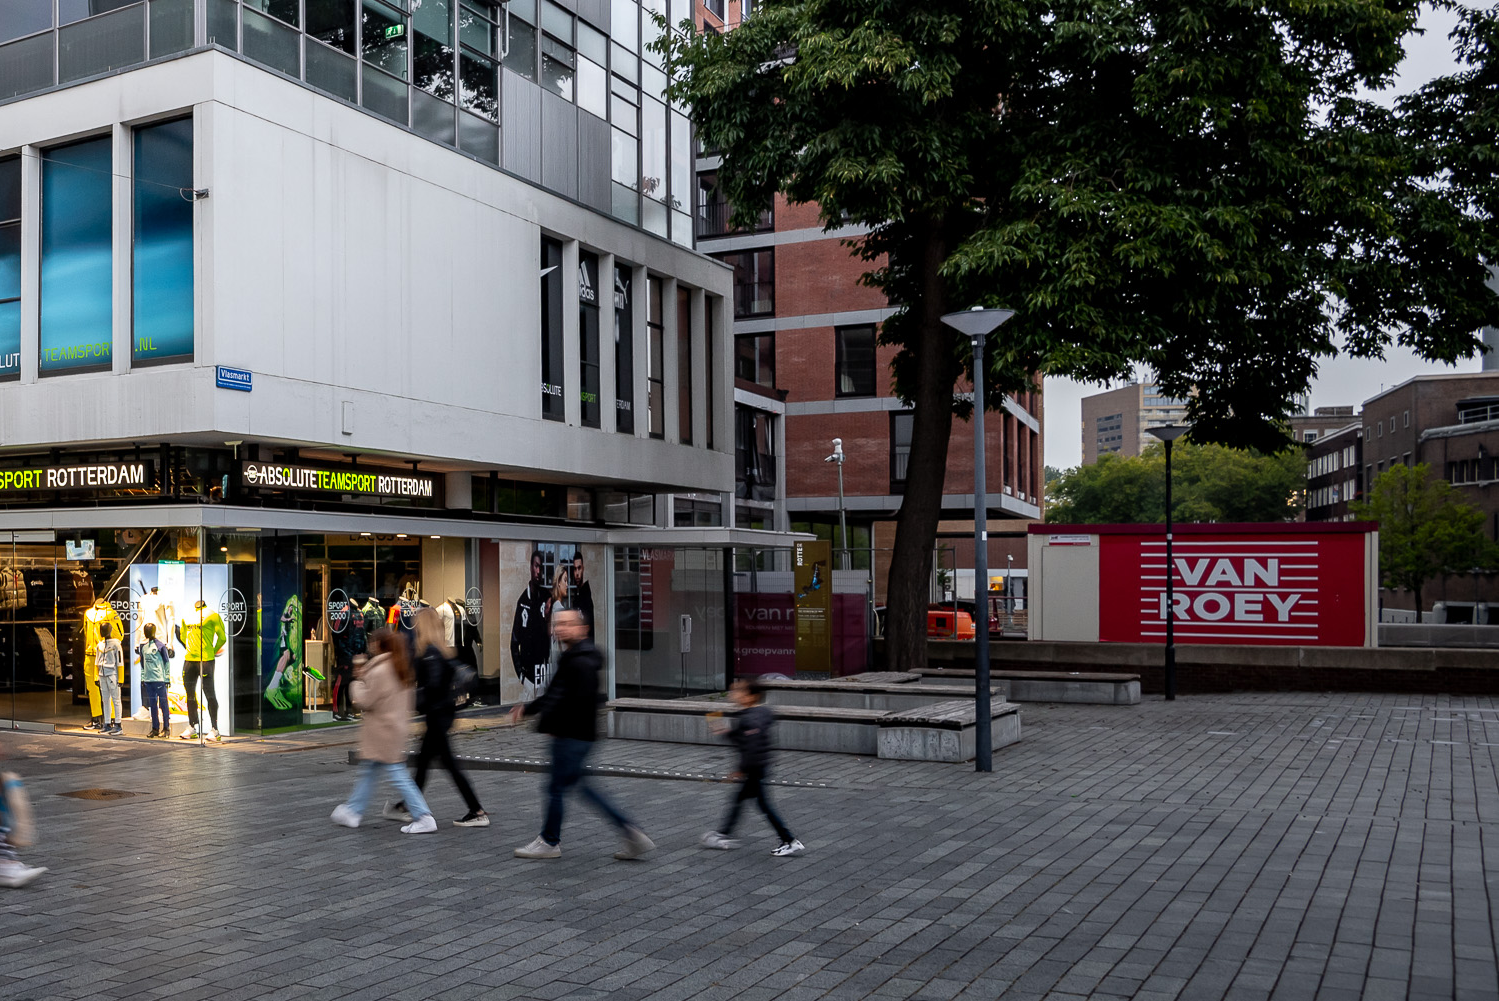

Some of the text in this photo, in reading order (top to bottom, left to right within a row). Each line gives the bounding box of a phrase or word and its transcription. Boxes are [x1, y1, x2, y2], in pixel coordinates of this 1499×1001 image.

[43, 342, 113, 362] TEAMSPOR
[220, 368, 250, 382] Vlasmarkt
[47, 463, 144, 488] ROTTERDAM
[259, 465, 433, 497] ABSOLUTETEAMSPORT ROTTERDAM
[1173, 558, 1279, 587] VAN
[110, 601, 141, 610] SPORT
[221, 602, 244, 611] SPORT
[328, 601, 348, 610] SPORT
[1159, 592, 1301, 622] ROEY
[223, 613, 243, 622] 2000
[330, 612, 346, 621] 2000
[744, 607, 781, 621] van
